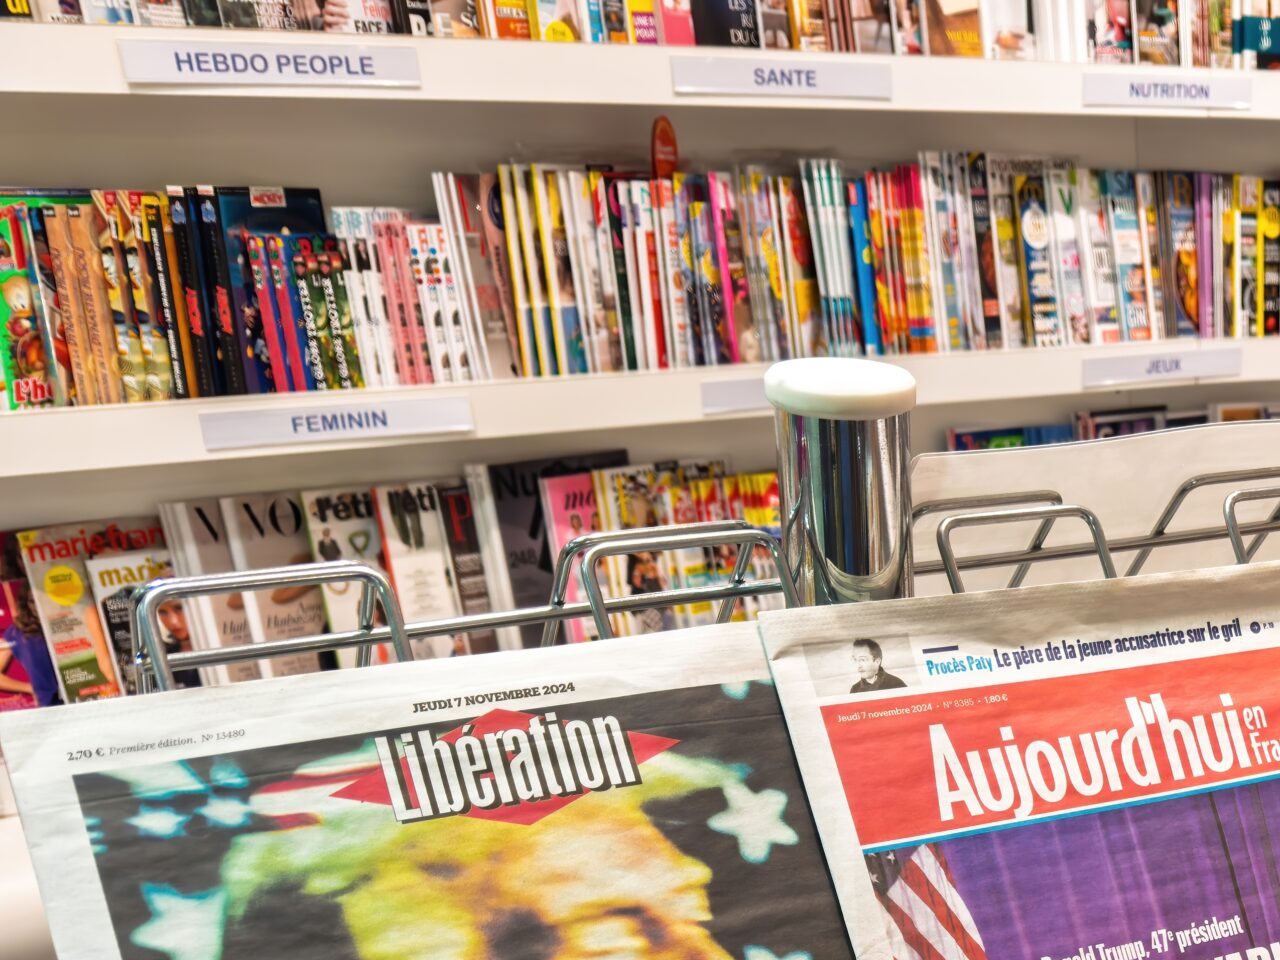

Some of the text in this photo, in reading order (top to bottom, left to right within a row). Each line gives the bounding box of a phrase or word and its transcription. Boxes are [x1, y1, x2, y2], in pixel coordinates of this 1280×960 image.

[174, 51, 374, 75] HEBDO PEOPLE
[753, 67, 816, 87] SANTE
[1129, 82, 1209, 98] NUTRITION
[1146, 358, 1181, 374] JEUX
[291, 410, 387, 433] FEMININ
[926, 617, 1242, 674] Procès Paty Le père de la jeune accusatrice sur le gril
[412, 682, 575, 713] JEUDI 7 NOVEMBRE 2024
[66, 749, 93, 761] 2,70
[94, 747, 104, 757] €
[109, 742, 155, 755] Première
[157, 737, 196, 748] édition.
[216, 728, 245, 740] 13480
[926, 692, 1268, 822] Aujourd'hui en
[374, 710, 643, 823] Libération
[1175, 914, 1244, 952] président
